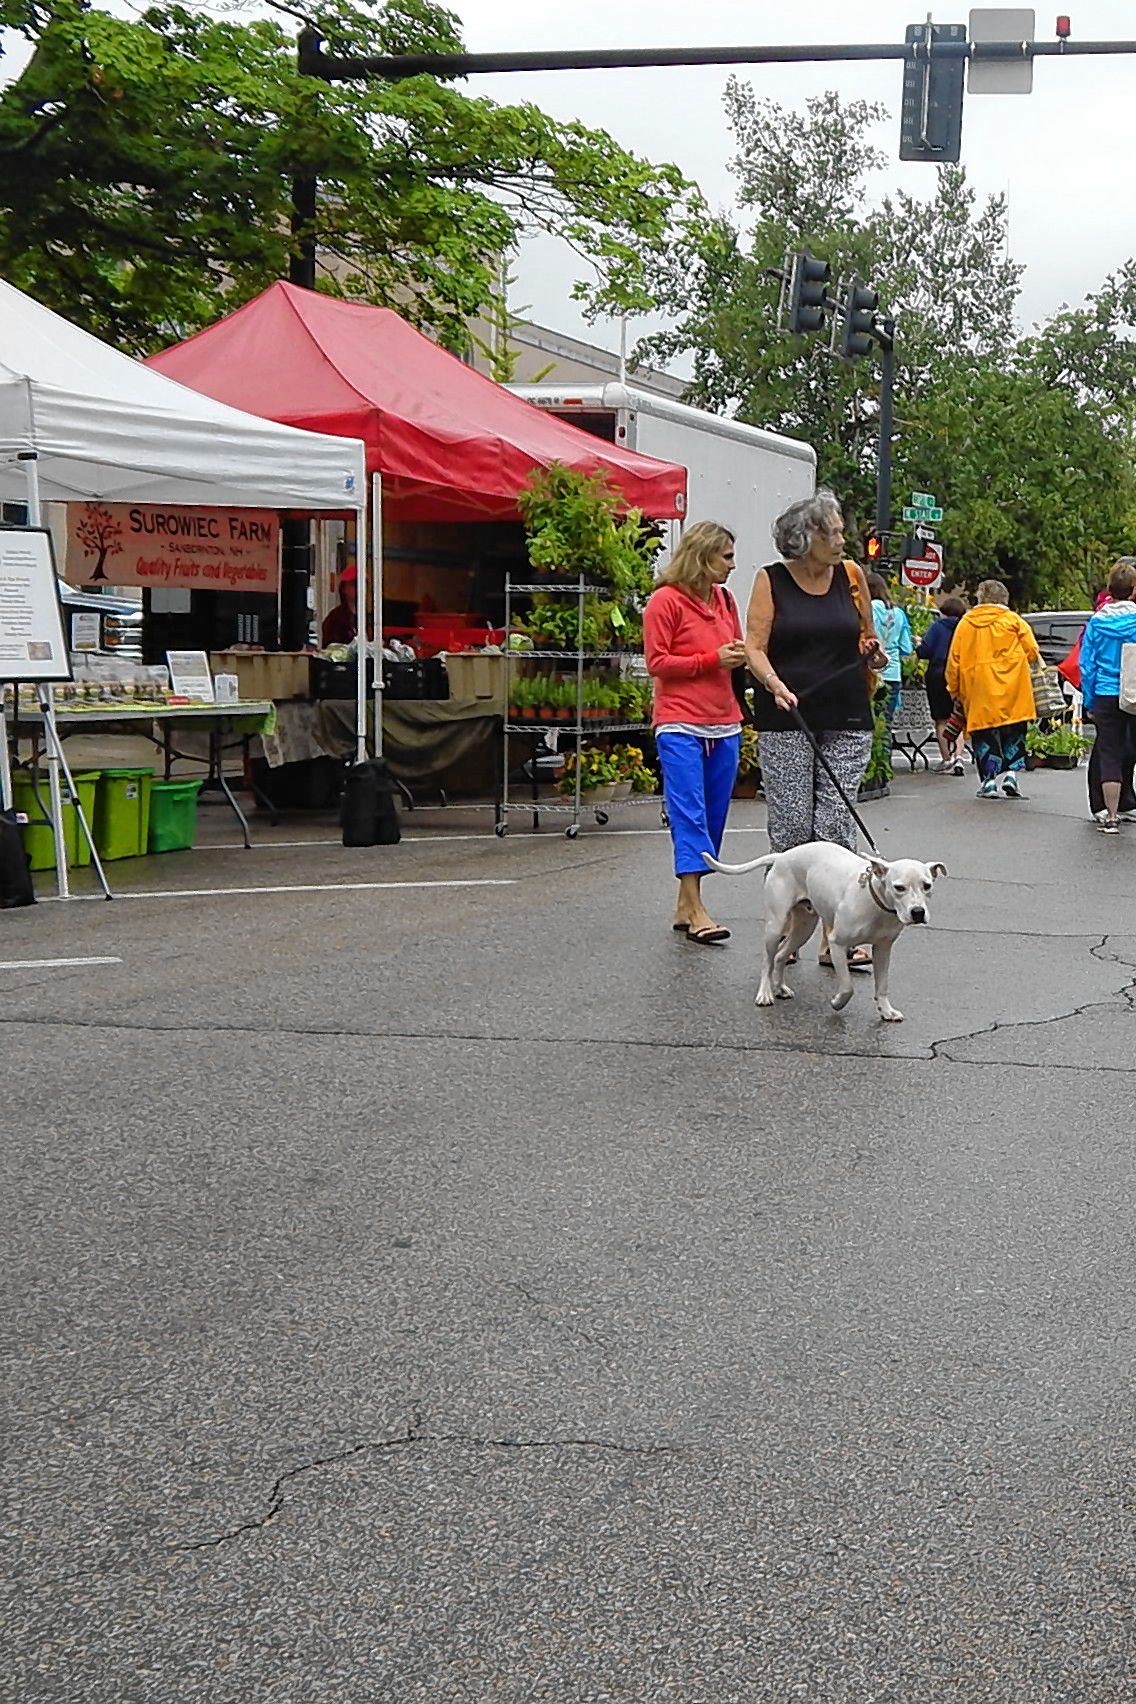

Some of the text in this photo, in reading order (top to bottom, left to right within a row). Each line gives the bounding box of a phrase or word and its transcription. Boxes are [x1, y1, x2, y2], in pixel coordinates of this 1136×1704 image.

[129, 508, 272, 543] SUROWIEC FARM
[136, 556, 269, 585] Quality Fruits and Vegetables
[911, 570, 932, 578] ENTER
